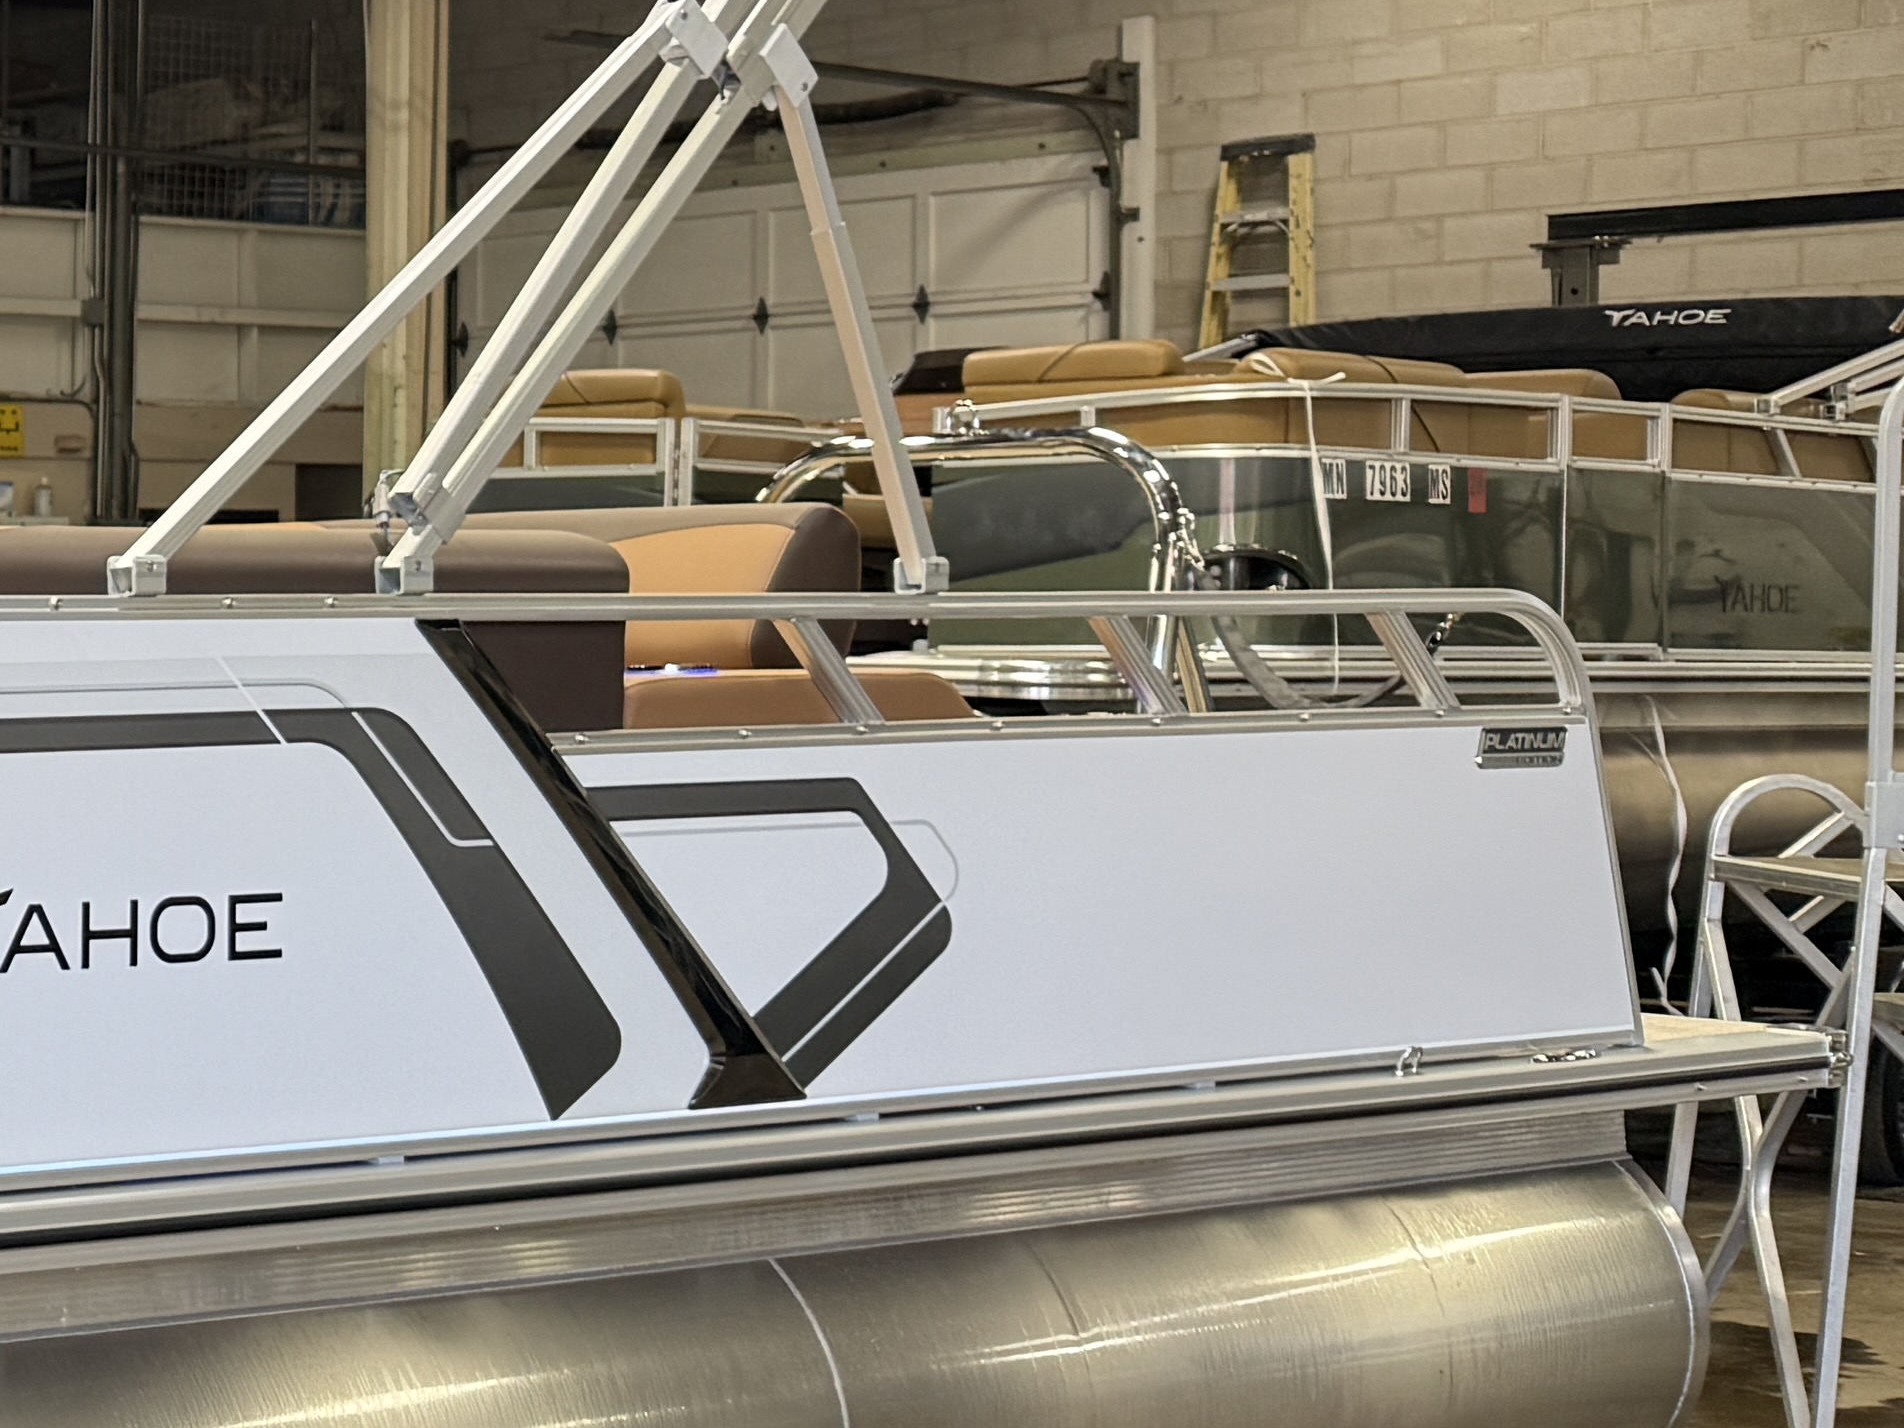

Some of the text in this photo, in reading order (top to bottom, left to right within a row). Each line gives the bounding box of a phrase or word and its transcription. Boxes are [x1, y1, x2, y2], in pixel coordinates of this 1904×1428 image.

[1604, 309, 1732, 327] TAHOE
[1323, 461, 1449, 500] MN 7963 MS
[1714, 574, 1800, 614] TAHOE
[1484, 732, 1565, 750] PLATINUM
